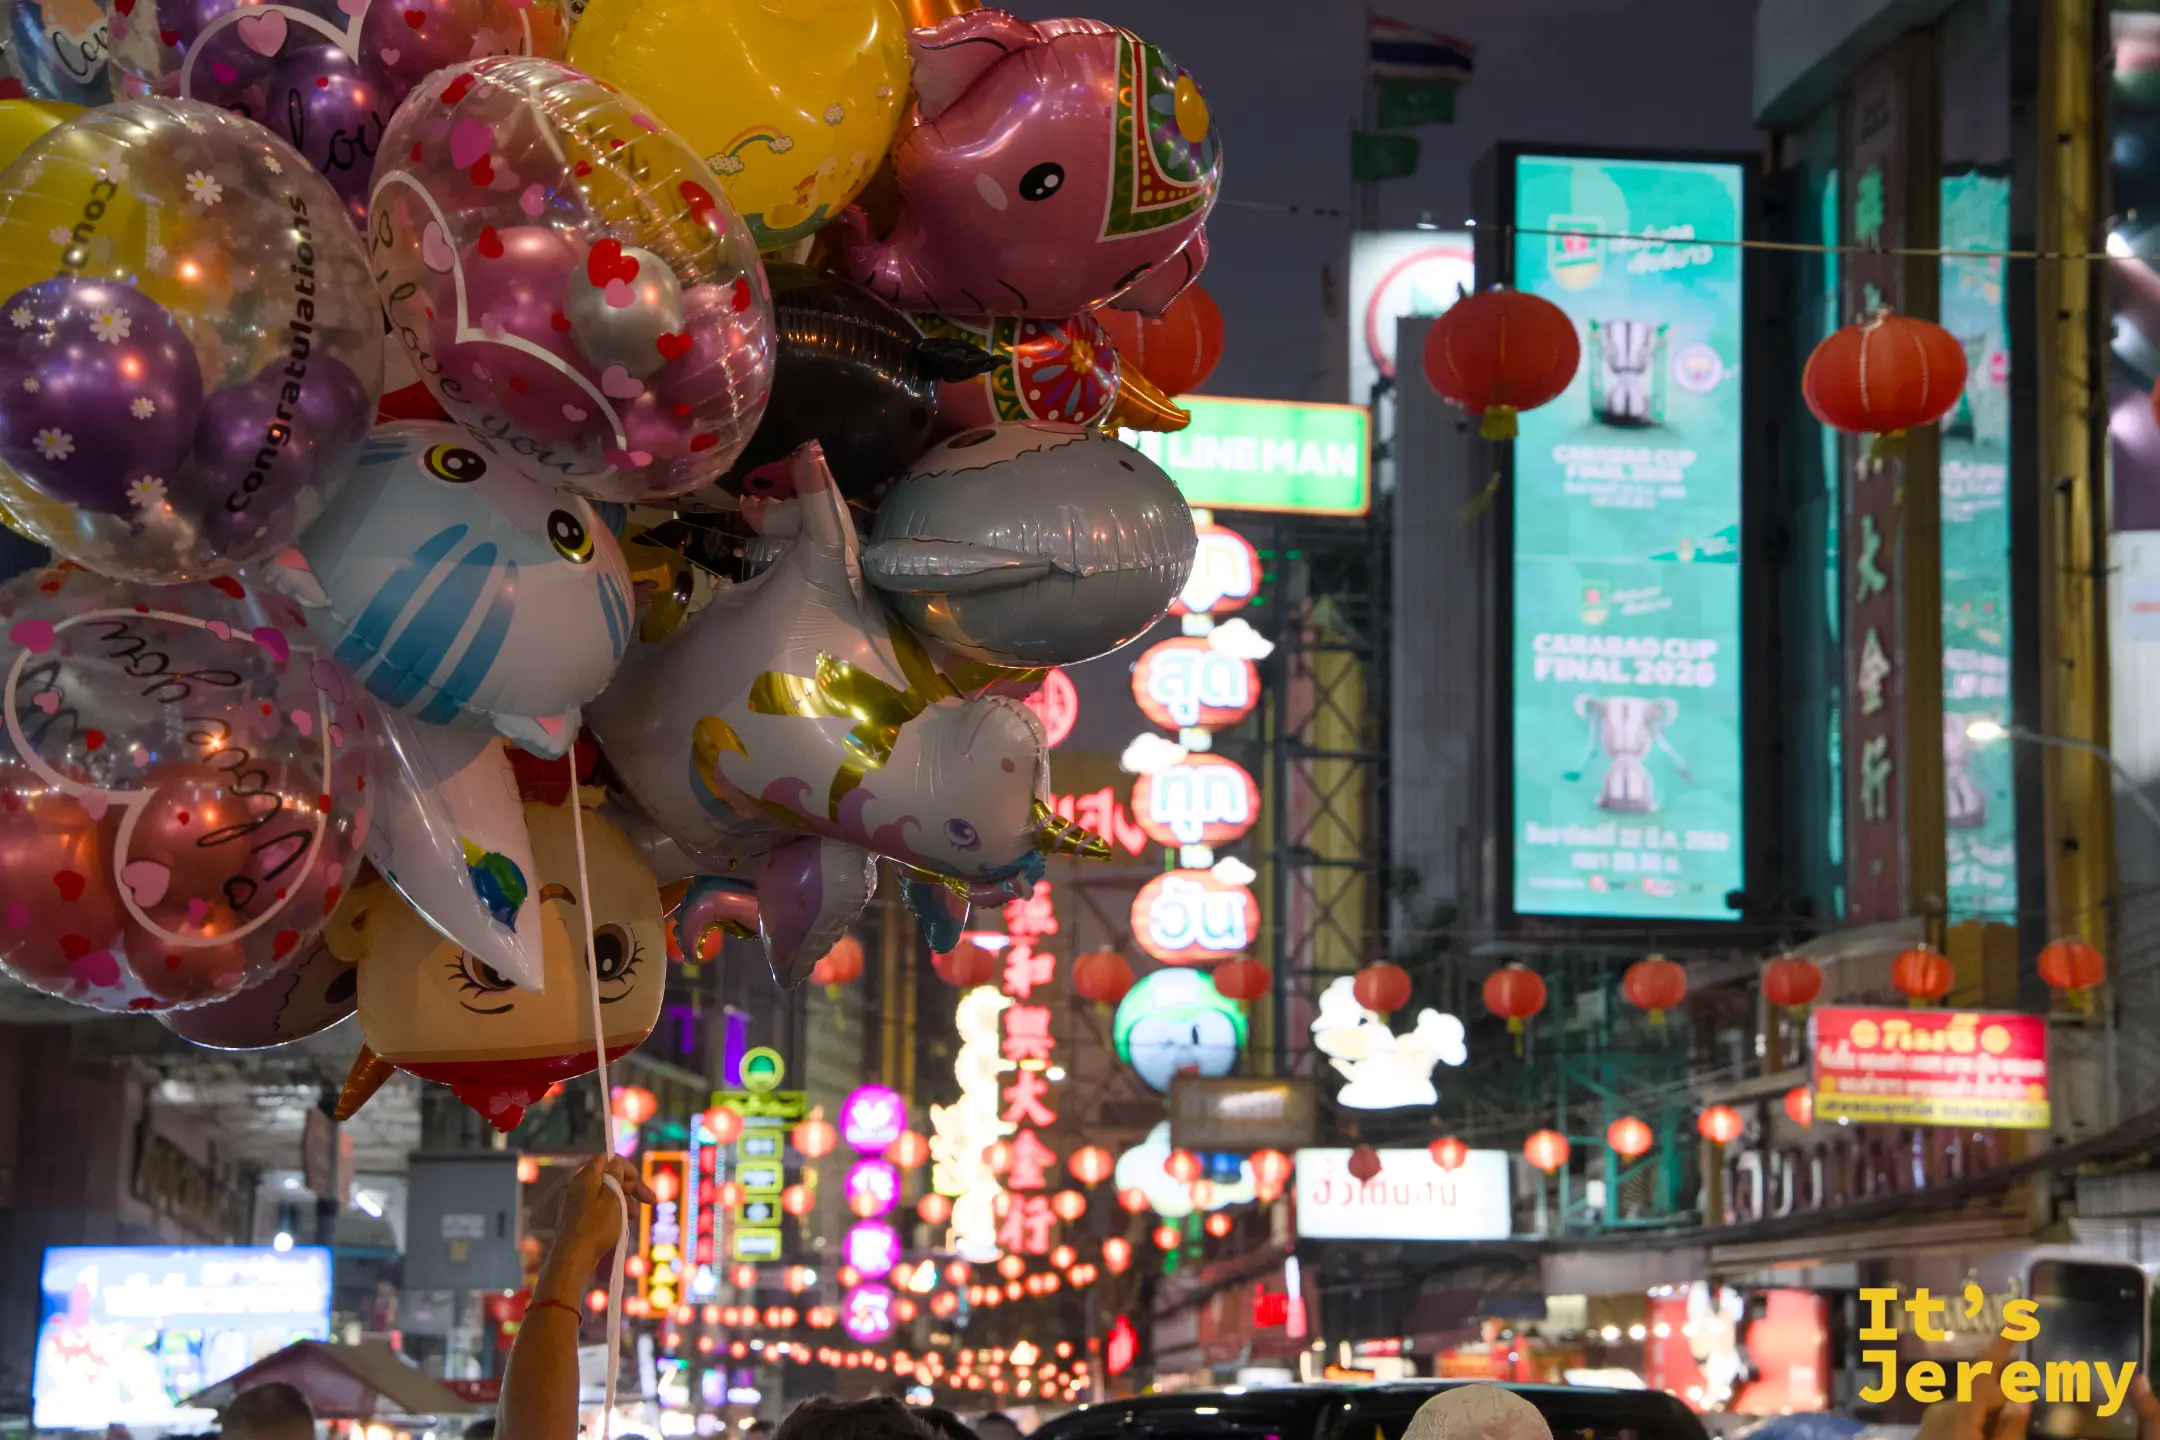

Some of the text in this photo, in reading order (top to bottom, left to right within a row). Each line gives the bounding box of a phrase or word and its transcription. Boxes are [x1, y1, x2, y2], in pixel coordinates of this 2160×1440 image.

[226, 193, 316, 514] Congratulations
[1532, 633, 1718, 660] CARABAO CUP
[1533, 655, 1631, 684] FINAL
[184, 716, 283, 848] love
[1149, 764, 1250, 844] ทุก
[1149, 876, 1248, 950] วัน
